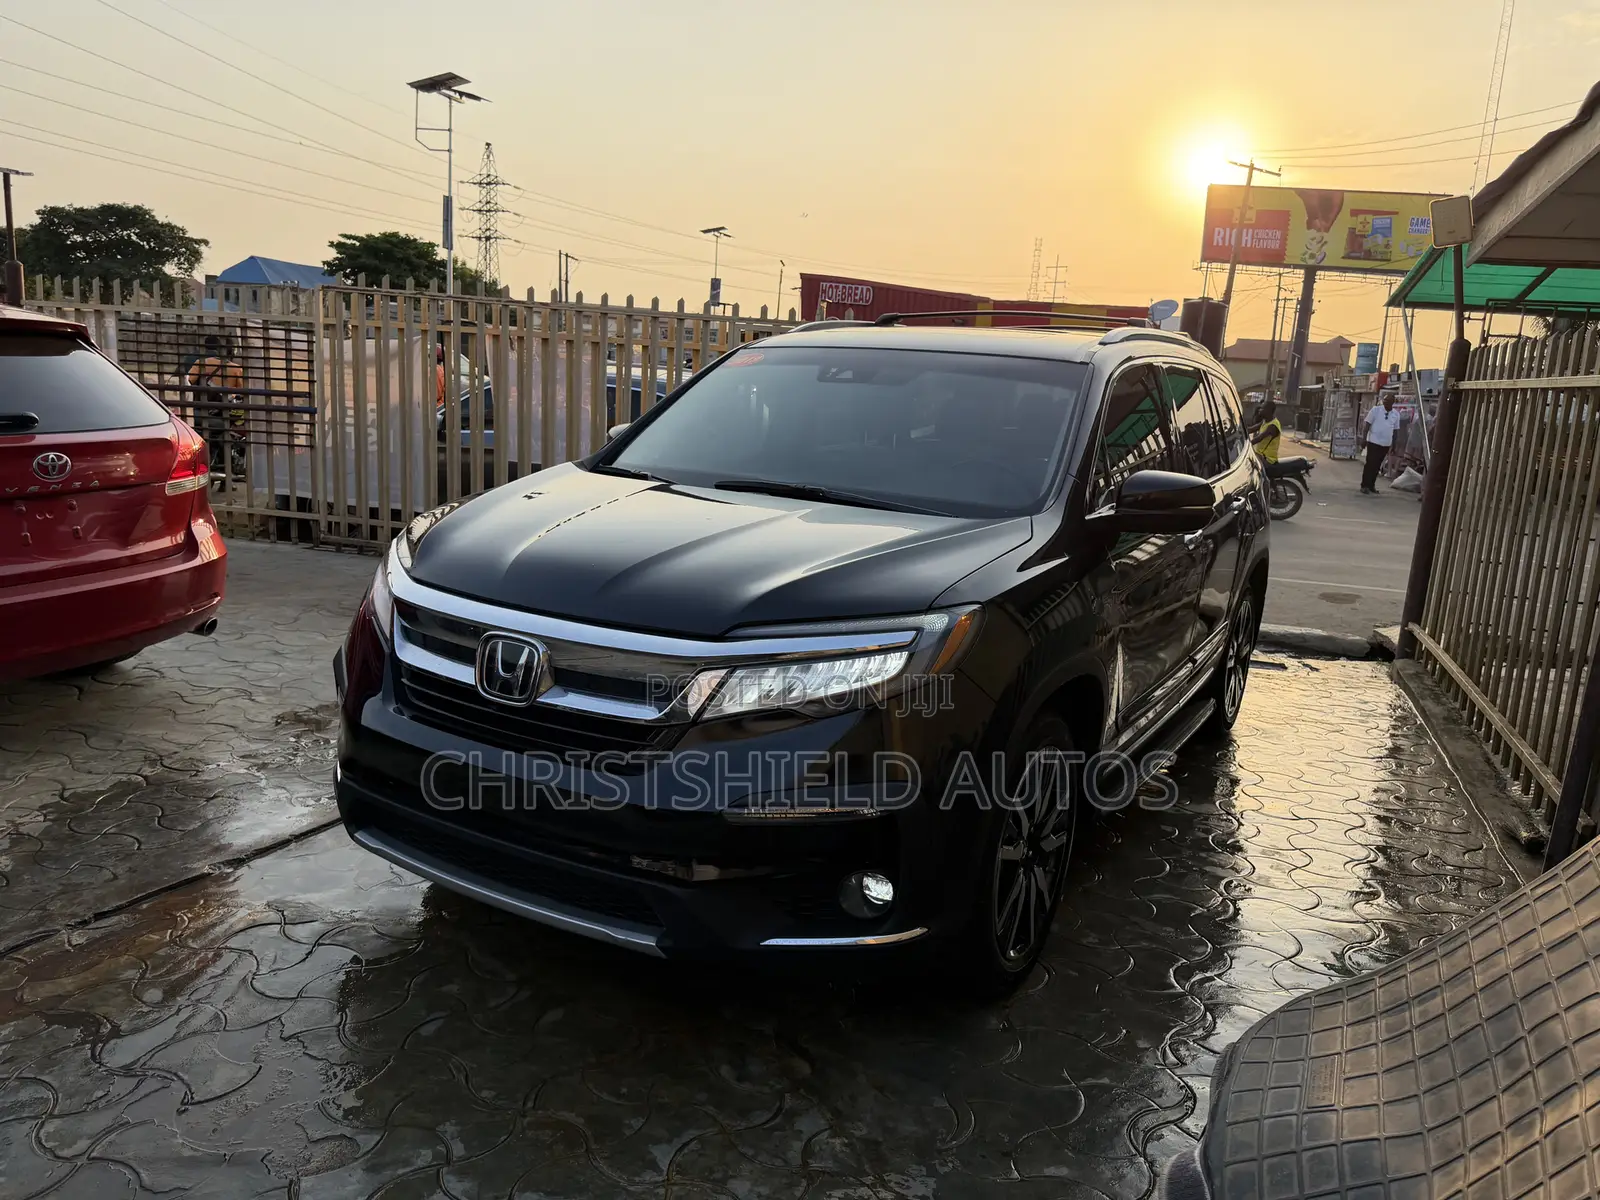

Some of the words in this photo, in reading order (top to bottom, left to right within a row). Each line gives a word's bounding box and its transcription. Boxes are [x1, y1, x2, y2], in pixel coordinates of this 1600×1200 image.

[1410, 217, 1431, 228] GAME
[1254, 229, 1282, 240] CHICKEN
[1252, 238, 1281, 249] FLAVOUR
[4, 480, 100, 493] VENZA
